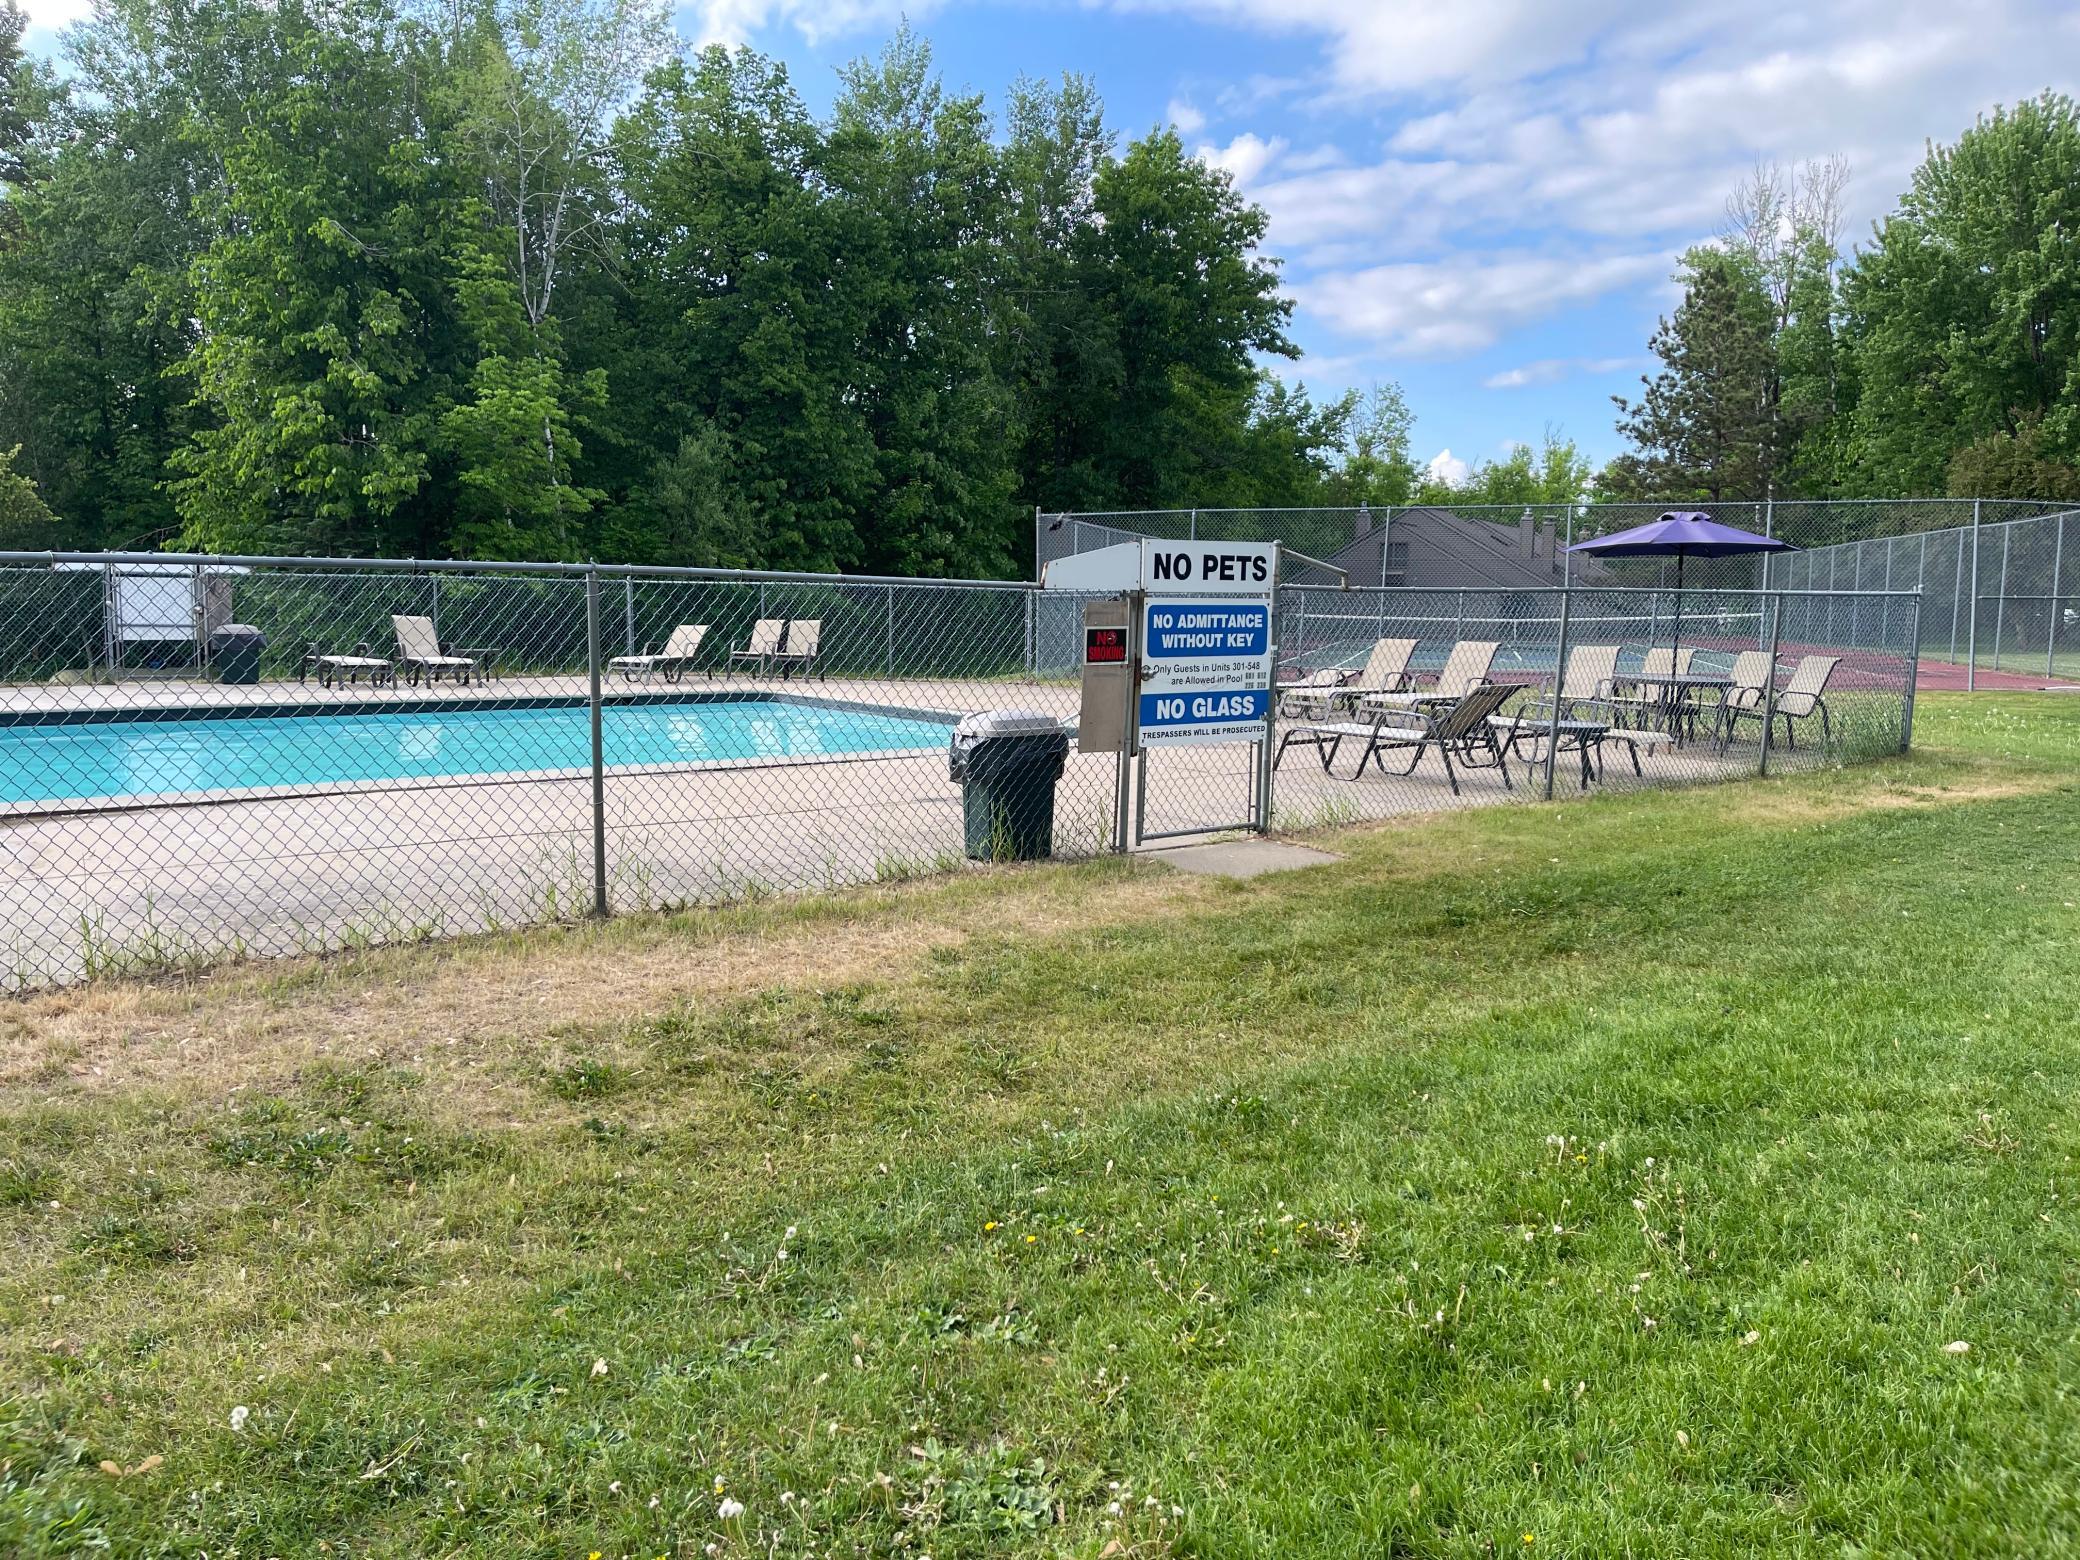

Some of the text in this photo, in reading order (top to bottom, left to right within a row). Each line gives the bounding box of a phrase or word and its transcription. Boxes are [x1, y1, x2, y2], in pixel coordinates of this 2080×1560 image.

[1153, 553, 1267, 582] NO PETS
[1153, 613, 1264, 629] NO ADMITTANCE
[1096, 631, 1117, 645] NO
[1161, 633, 1255, 649] WITHOUT KEY
[1088, 645, 1124, 660] SMOKING
[1153, 661, 1261, 676] Only Guests in Units 301-548
[1171, 674, 1243, 686] are Allowed in Pool
[1156, 695, 1255, 720] NO GLASS
[1142, 725, 1266, 740] TRESPASSERS WILL BE PROSECUTED
